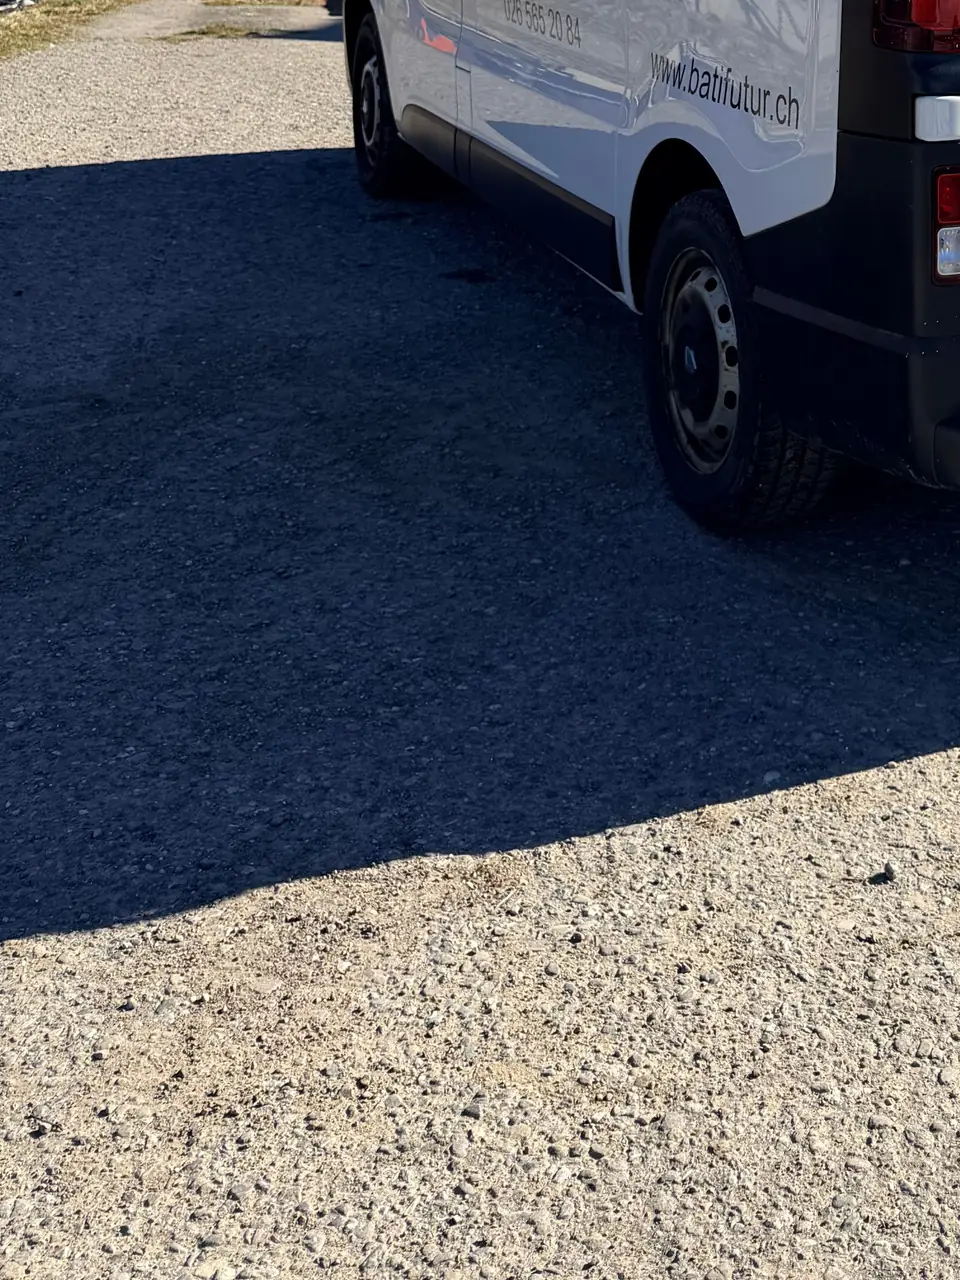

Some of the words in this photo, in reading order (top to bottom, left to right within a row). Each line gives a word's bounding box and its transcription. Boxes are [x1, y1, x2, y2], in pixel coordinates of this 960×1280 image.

[525, 0, 546, 35] 565
[548, 8, 563, 41] 20
[566, 14, 581, 49] 84
[651, 52, 800, 130] www.batifutur.ch
